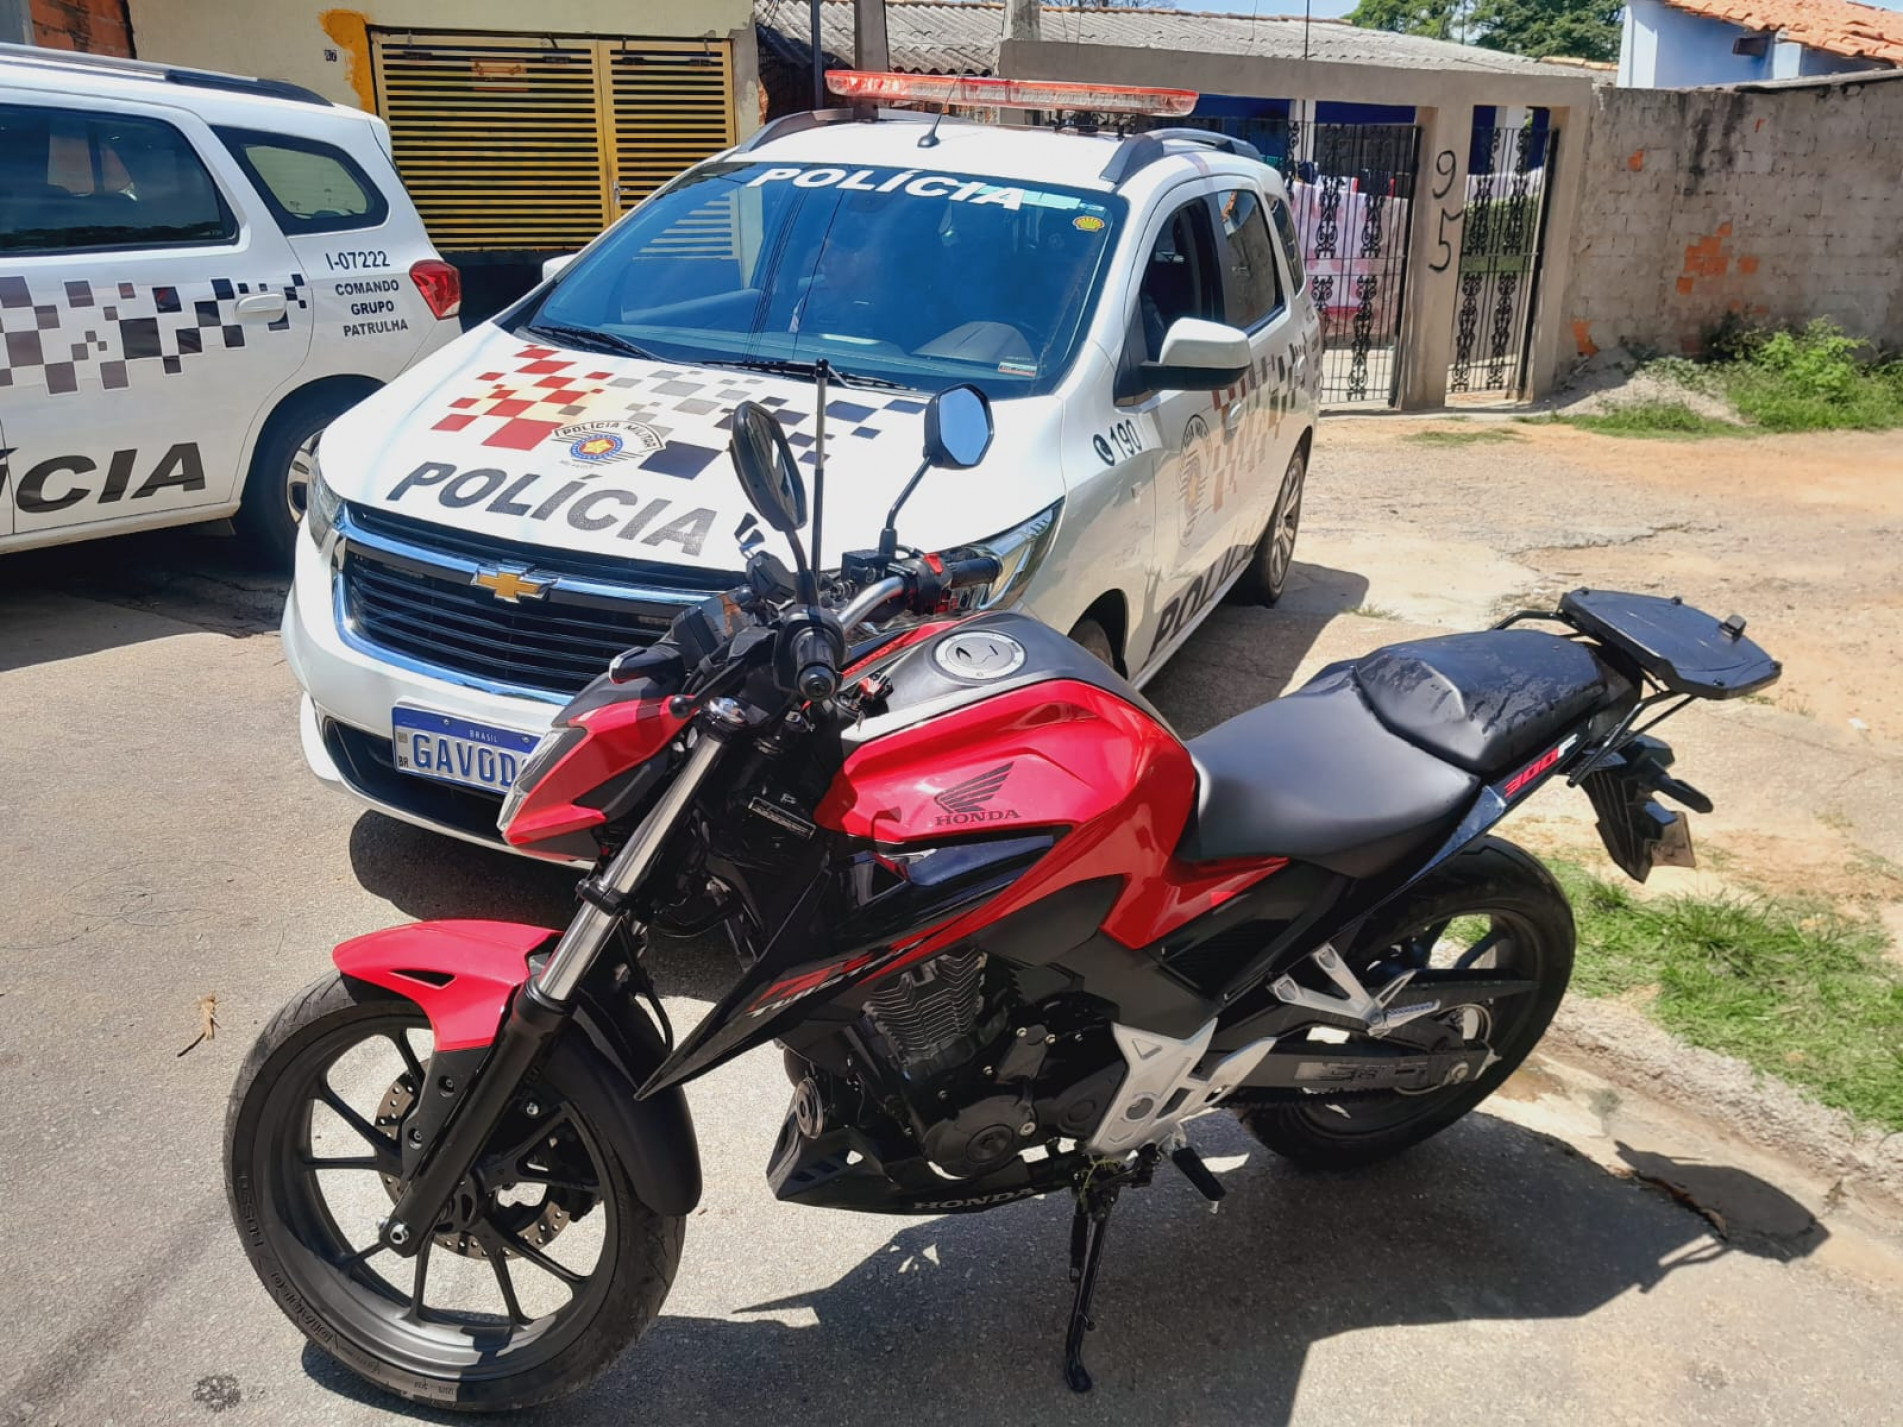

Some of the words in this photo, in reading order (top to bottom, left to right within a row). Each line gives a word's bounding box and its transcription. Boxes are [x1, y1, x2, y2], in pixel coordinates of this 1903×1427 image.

[746, 168, 1025, 211] POLÍCIA
[325, 250, 391, 271] I-07222
[335, 279, 399, 296] COMANDO
[351, 300, 394, 315] GRUPO
[343, 318, 408, 337] PATRULHA
[1109, 418, 1143, 459] 190
[386, 461, 717, 556] POLÍCIA
[469, 729, 499, 743] BRASIL
[1504, 733, 1578, 798] 300F
[935, 810, 1021, 826] HONDA
[914, 1187, 1036, 1209] HONDA
